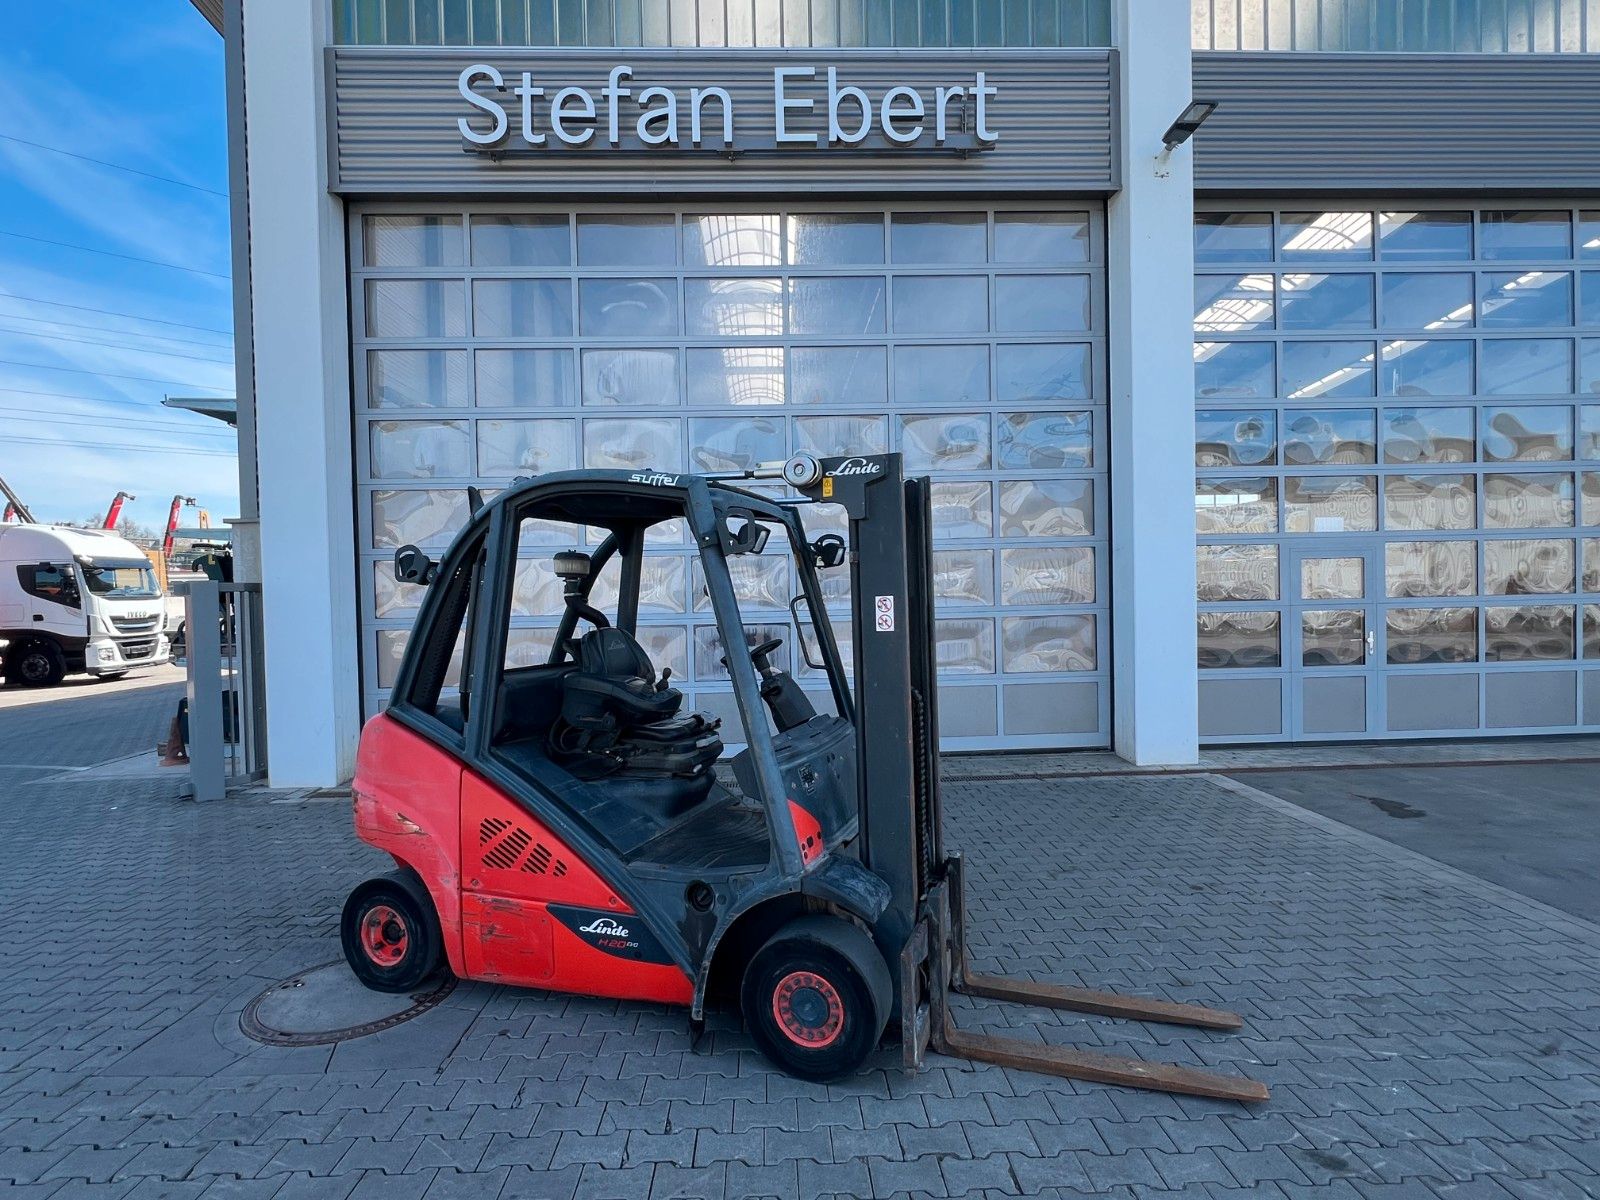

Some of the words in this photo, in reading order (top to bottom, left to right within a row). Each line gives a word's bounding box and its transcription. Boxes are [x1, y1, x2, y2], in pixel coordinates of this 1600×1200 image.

[457, 64, 733, 145] Stefan
[774, 66, 999, 144] Ebert
[825, 457, 880, 477] Linde
[579, 918, 629, 937] Linde
